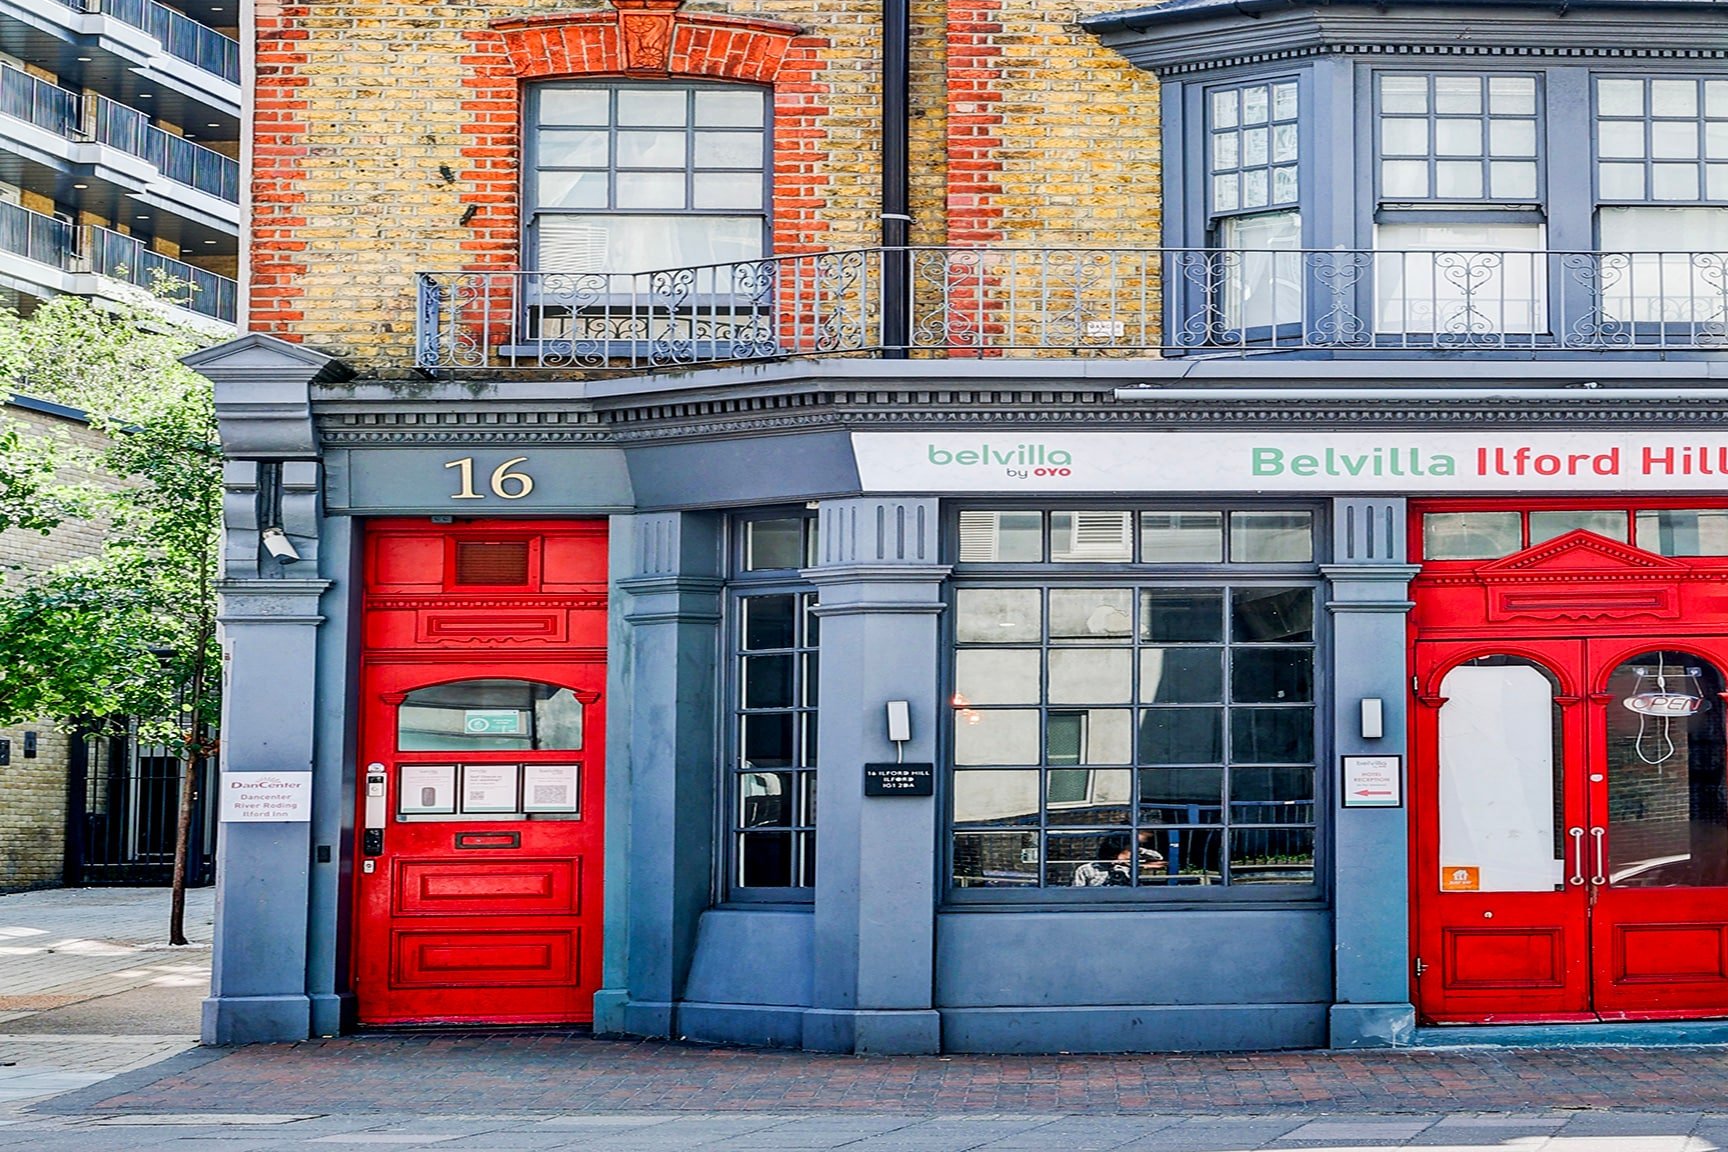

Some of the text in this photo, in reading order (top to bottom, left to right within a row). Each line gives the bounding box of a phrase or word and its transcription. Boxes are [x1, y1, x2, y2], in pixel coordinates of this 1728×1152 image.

[928, 444, 1072, 465] belvilla
[1251, 447, 1455, 476] Belvilla
[1477, 447, 1620, 476] Ilford
[444, 456, 535, 499] 16
[1006, 467, 1072, 479] by OYO
[1632, 696, 1704, 711] OPEN
[230, 781, 302, 789] DanCenter
[240, 793, 292, 801] Dancenter
[263, 802, 298, 810] Roding
